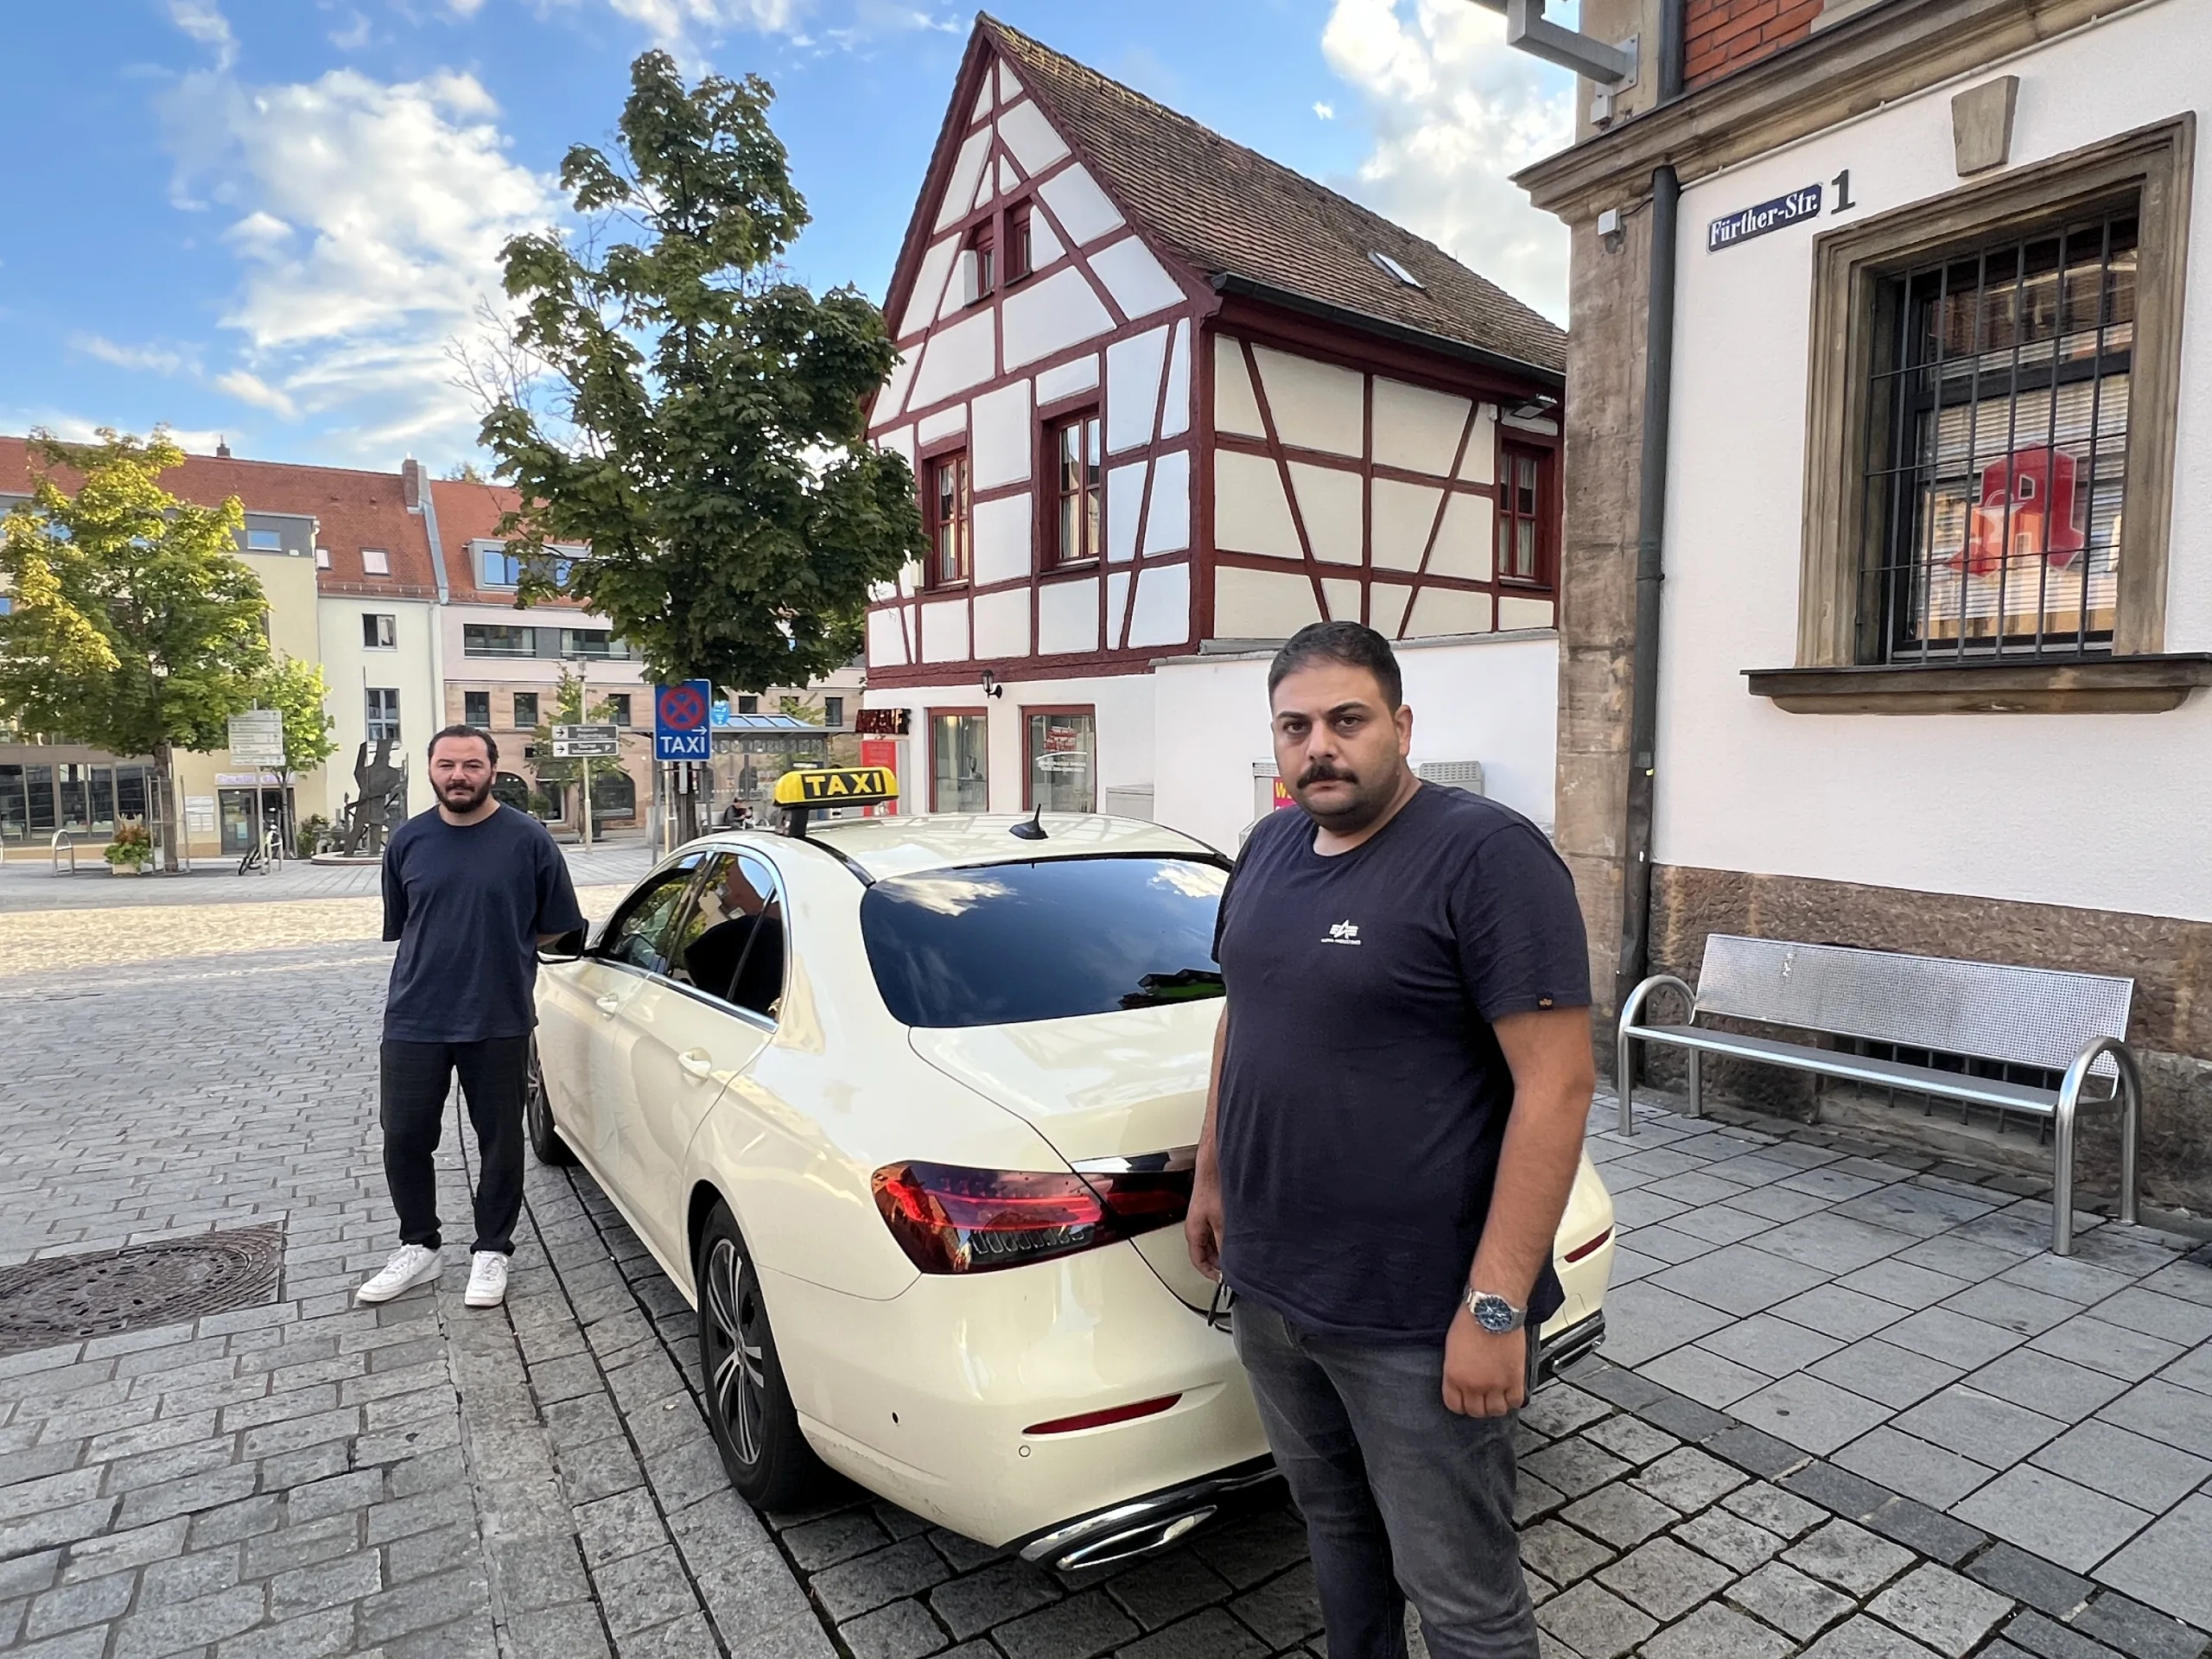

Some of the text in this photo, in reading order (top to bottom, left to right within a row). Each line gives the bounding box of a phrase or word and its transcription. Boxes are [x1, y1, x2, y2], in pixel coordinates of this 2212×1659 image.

[1831, 168, 1856, 215] 1
[1710, 192, 1818, 246] Fürther-Str.
[659, 735, 705, 753] TAXI
[804, 772, 882, 797] TAXI
